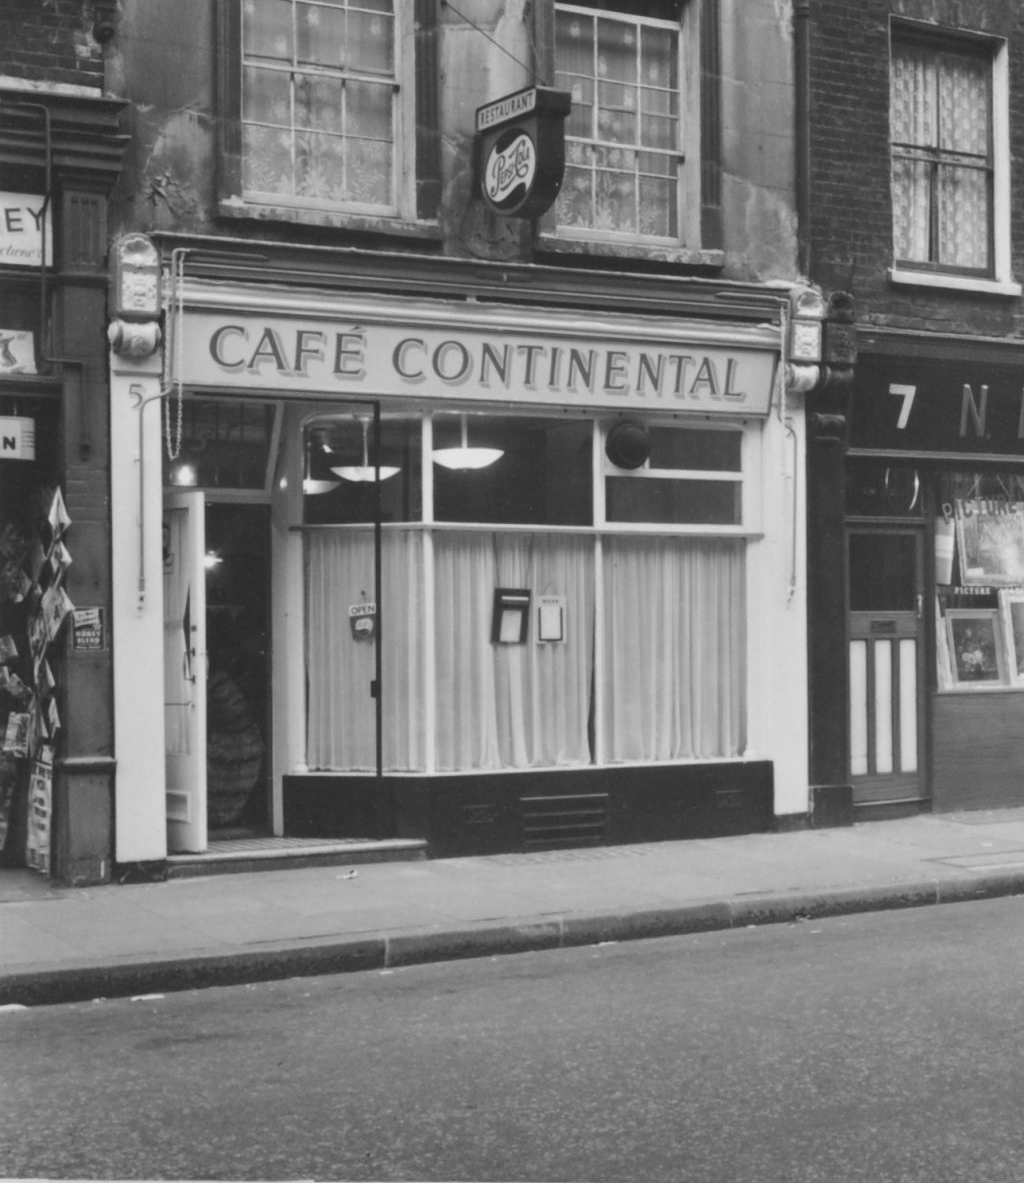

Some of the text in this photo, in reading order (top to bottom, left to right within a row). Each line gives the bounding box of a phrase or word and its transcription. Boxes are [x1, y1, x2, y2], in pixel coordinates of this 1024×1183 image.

[480, 92, 535, 125] RESTAURANT
[209, 324, 746, 400] CAFÉ CONTINENTAL
[128, 383, 145, 409] 5
[889, 383, 917, 430] 7
[941, 495, 1018, 525] PICTURE
[954, 586, 991, 596] PICTURE
[351, 604, 375, 615] OPEN
